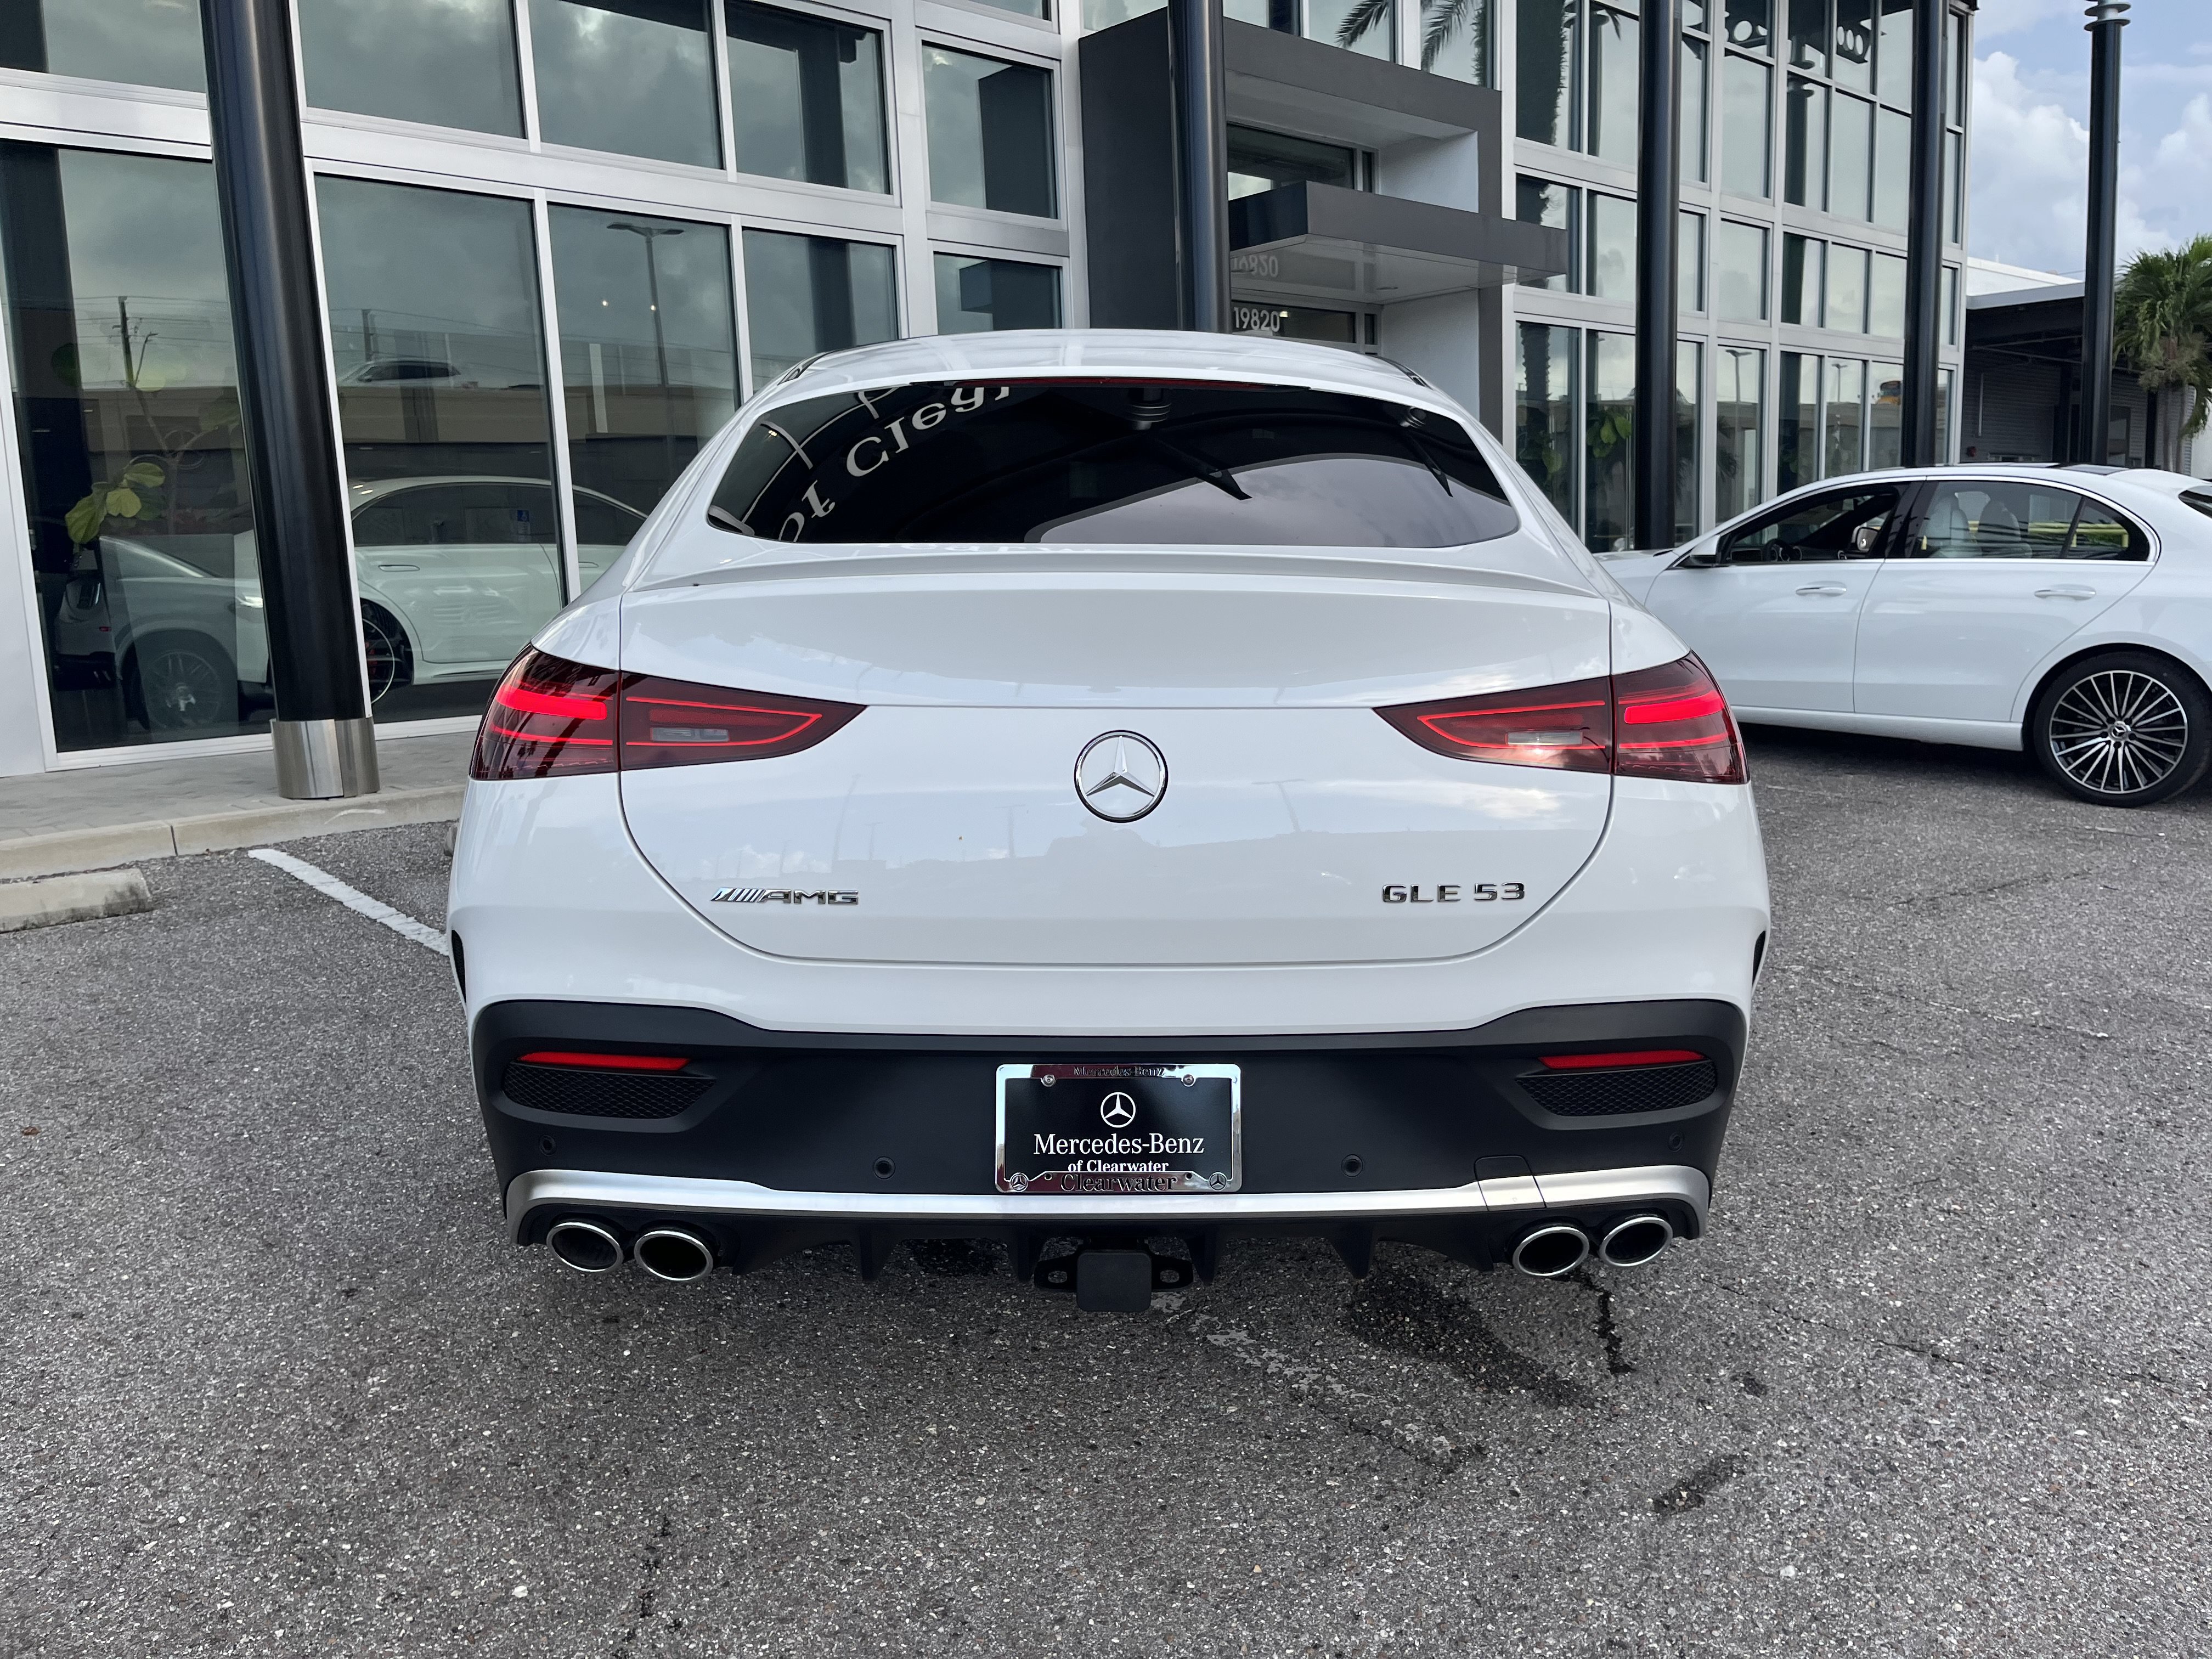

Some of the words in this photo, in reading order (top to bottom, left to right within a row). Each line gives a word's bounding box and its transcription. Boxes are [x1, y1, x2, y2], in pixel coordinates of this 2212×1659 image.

[1234, 307, 1280, 332] 19820
[1382, 883, 1462, 902] GLE
[1474, 881, 1525, 901] 53
[1033, 1132, 1205, 1155] Mercedes-Benz
[1068, 1160, 1084, 1172] of
[1086, 1160, 1169, 1172] Clearwater
[1060, 1173, 1177, 1192] Clearwater
